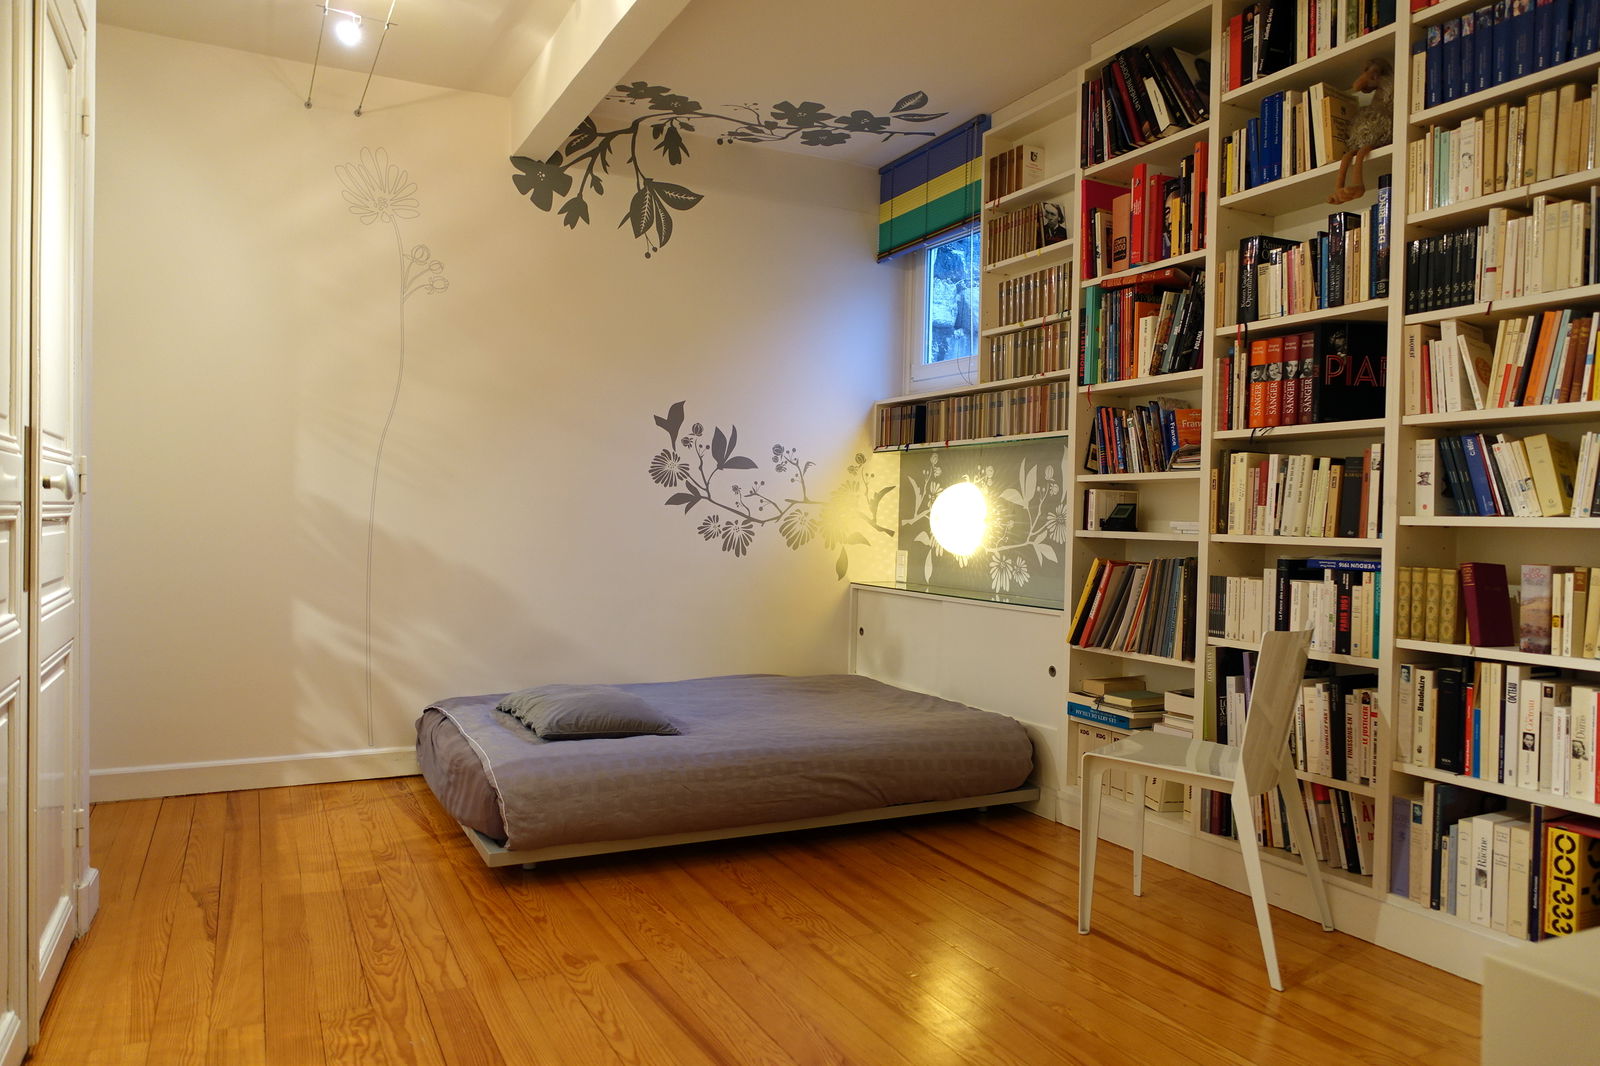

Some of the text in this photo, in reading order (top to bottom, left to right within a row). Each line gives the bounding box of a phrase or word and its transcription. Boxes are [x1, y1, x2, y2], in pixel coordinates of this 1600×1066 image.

[1194, 330, 1203, 350] POLINA
[1254, 384, 1262, 416] SÄNGER
[1286, 380, 1294, 414] SÄNGER
[1304, 378, 1312, 412] SÄNGER
[1182, 420, 1200, 428] Fran
[1417, 676, 1425, 712] Baudelaire
[1508, 682, 1517, 704] COCTEAU
[1476, 837, 1488, 867] Racine
[1552, 833, 1576, 935] 001-333
